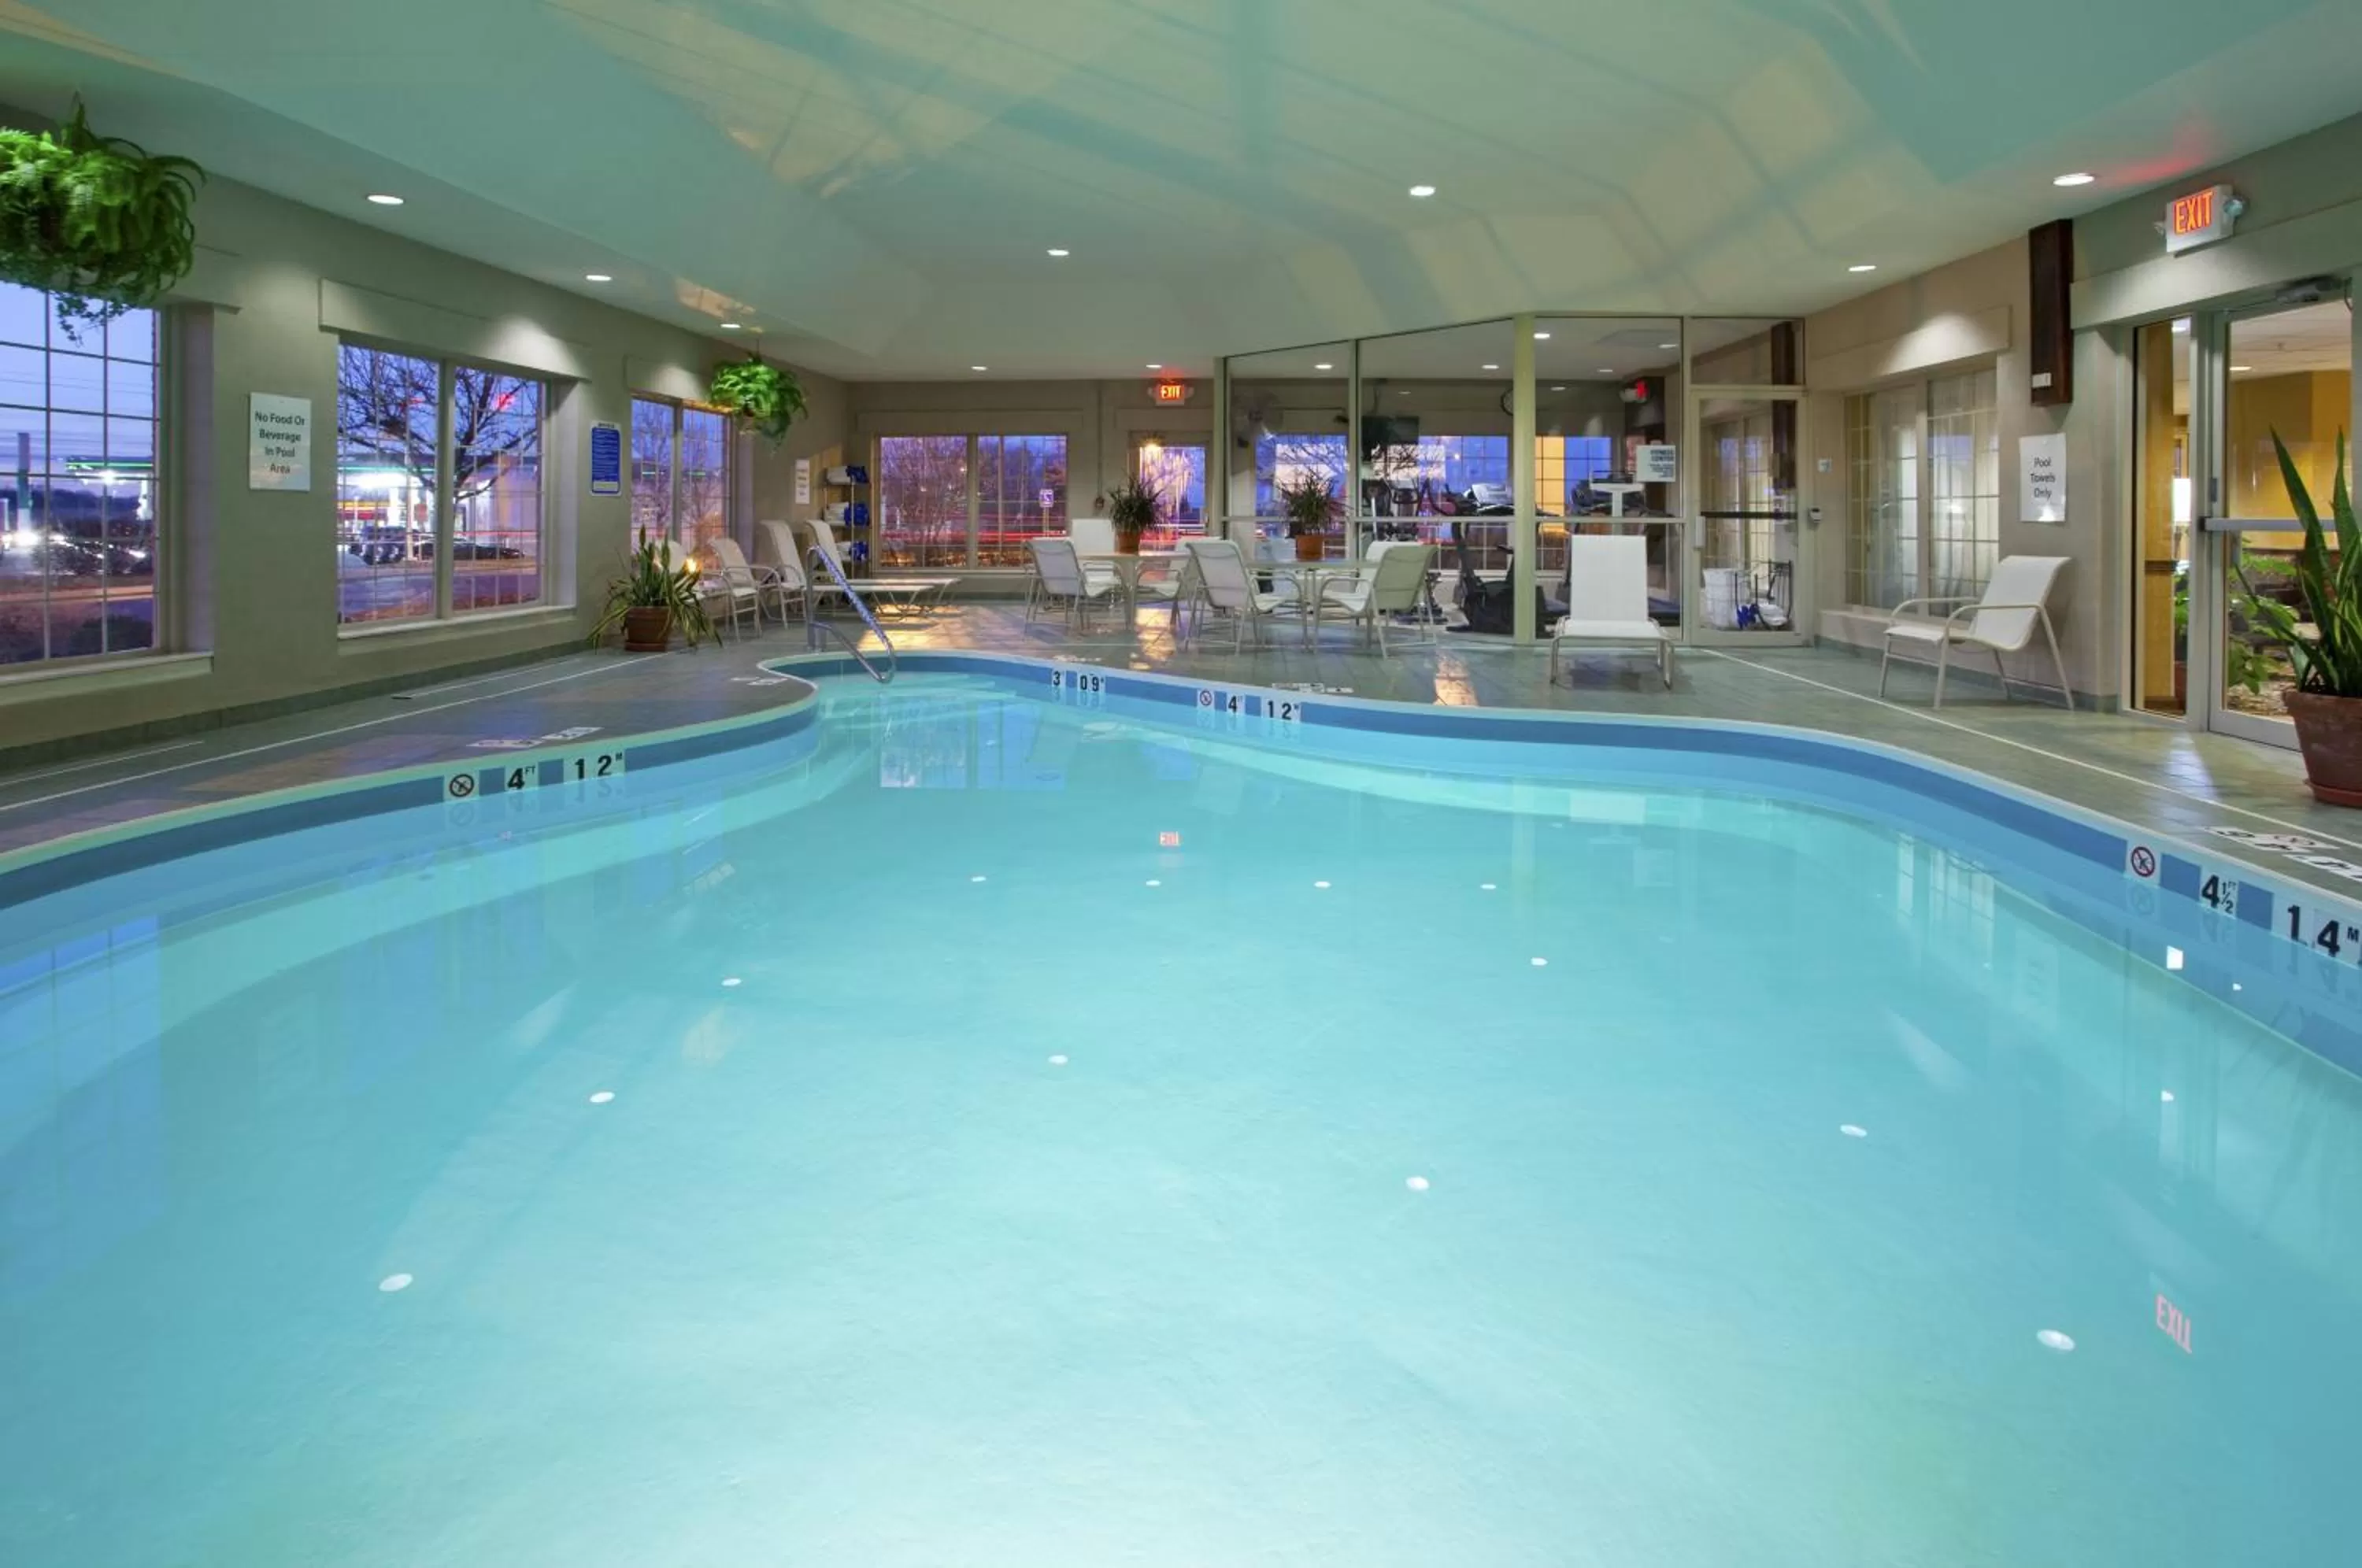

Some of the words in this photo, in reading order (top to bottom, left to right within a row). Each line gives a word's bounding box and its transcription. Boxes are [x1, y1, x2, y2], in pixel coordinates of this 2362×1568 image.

[2175, 190, 2214, 235] EXIT
[1161, 385, 1181, 399] EXIT
[254, 410, 268, 423] No
[270, 412, 293, 424] Food
[294, 415, 305, 426] Or
[259, 428, 302, 443] Beverage
[276, 446, 295, 457] Pool
[270, 463, 291, 474] Area
[2034, 457, 2051, 468] Pool
[2030, 472, 2056, 483] Towels
[2034, 487, 2052, 501] Only
